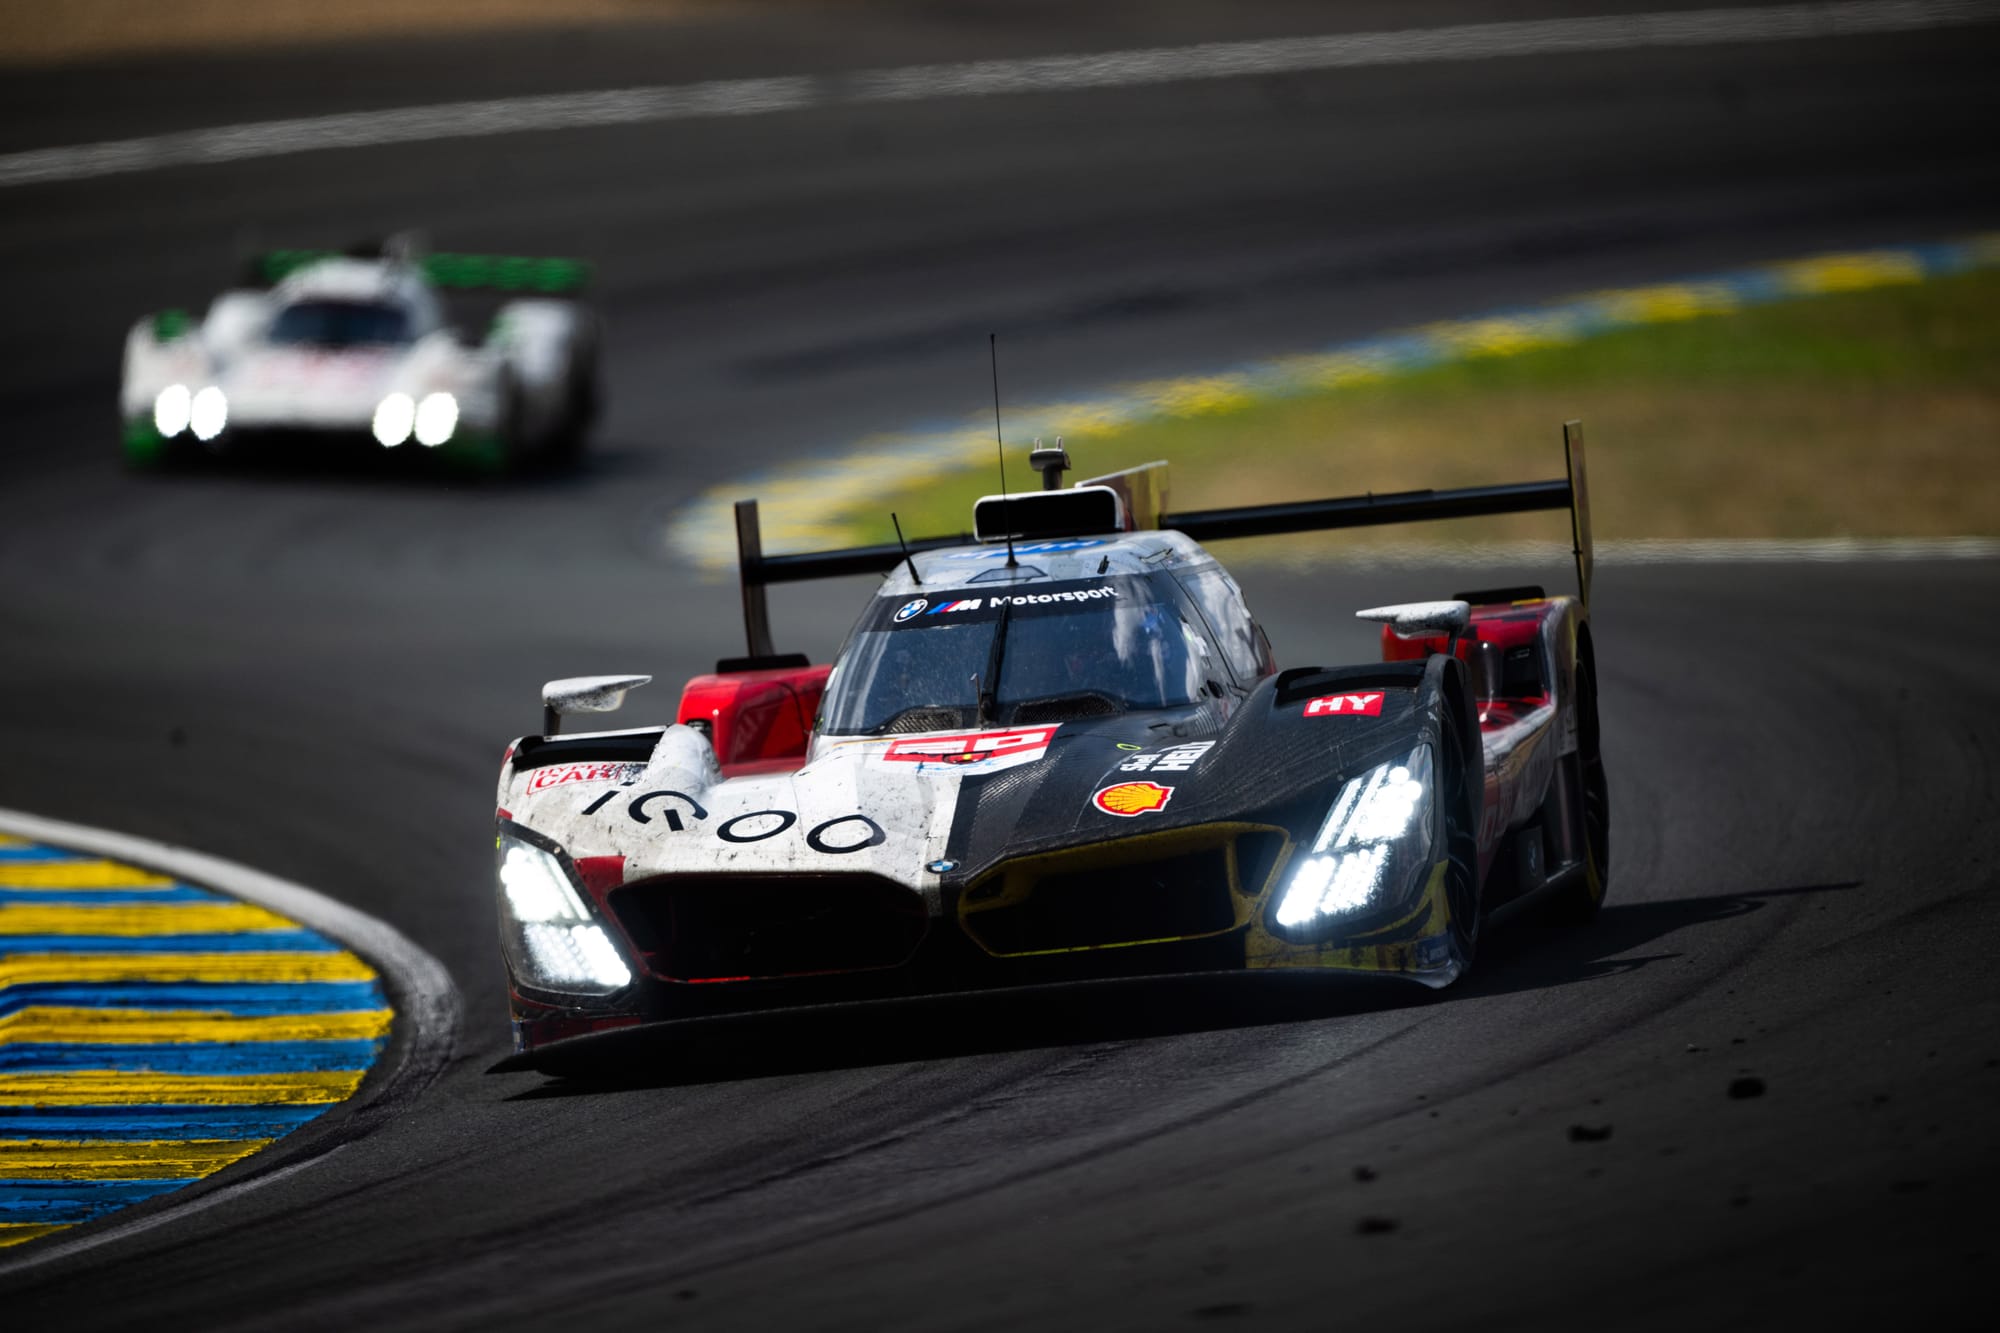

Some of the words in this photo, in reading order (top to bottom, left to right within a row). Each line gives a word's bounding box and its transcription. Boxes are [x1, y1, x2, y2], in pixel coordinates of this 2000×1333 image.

[990, 586, 1119, 608] Motorsport
[1307, 694, 1381, 714] HY
[535, 768, 613, 789] CAR
